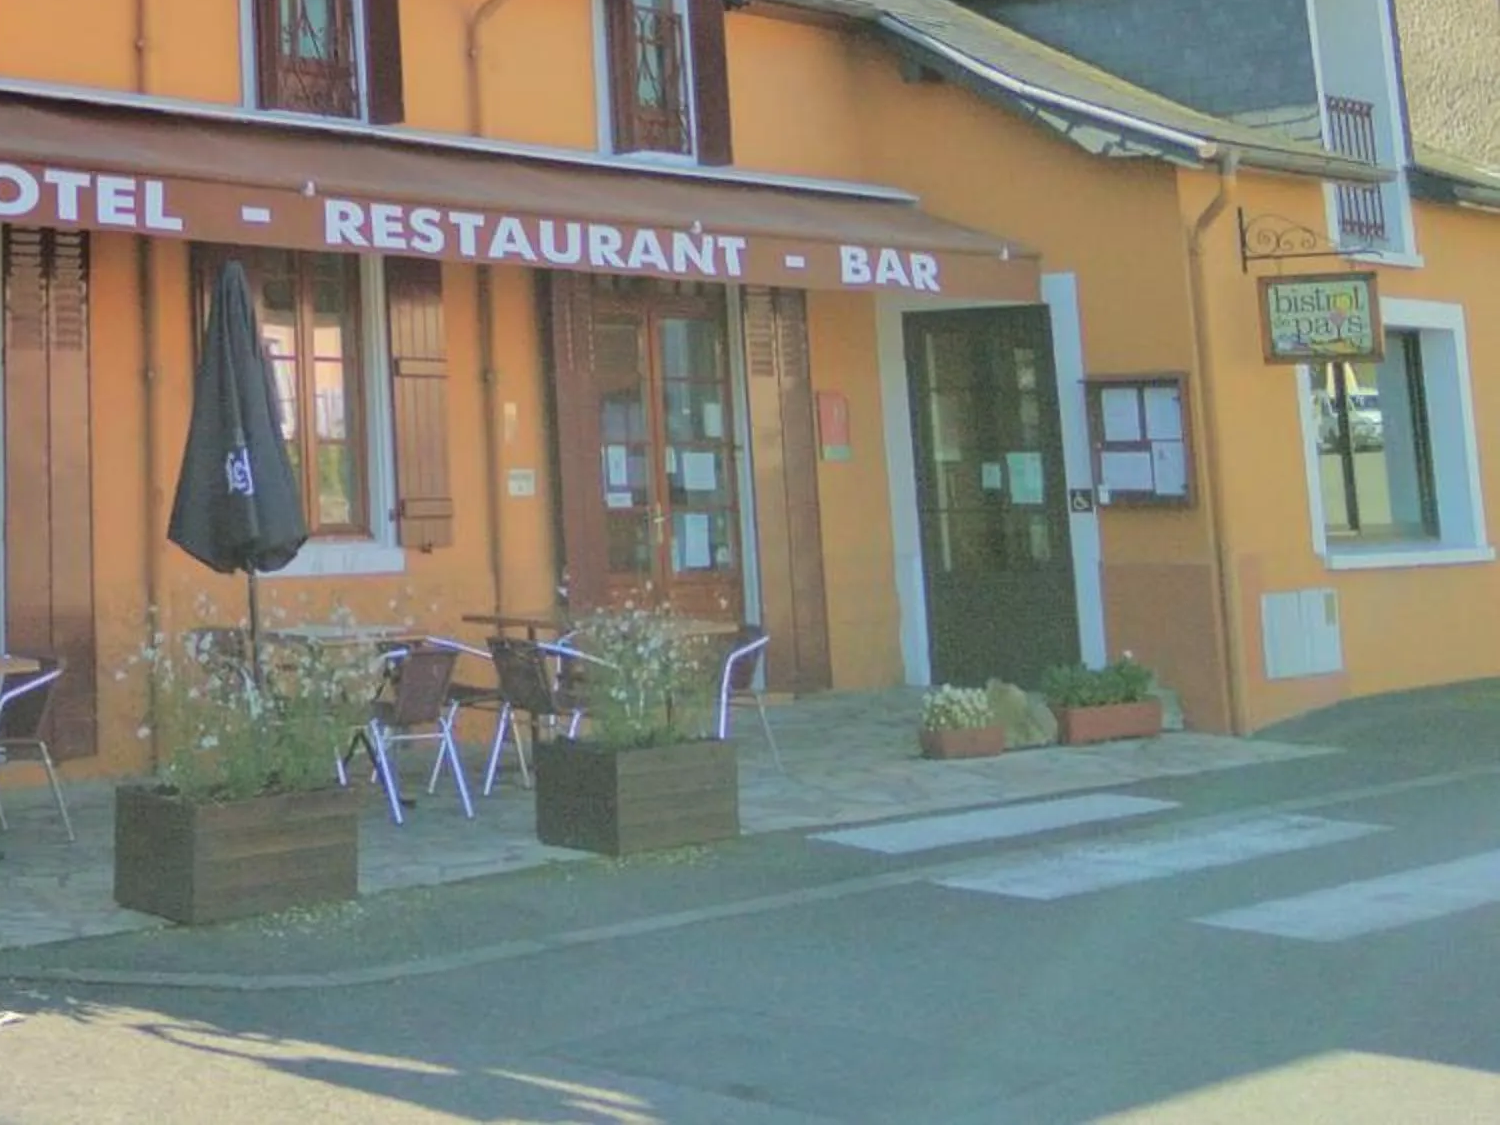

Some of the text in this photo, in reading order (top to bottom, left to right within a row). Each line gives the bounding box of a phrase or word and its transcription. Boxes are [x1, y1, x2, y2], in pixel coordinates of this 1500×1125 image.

[241, 206, 270, 222] -
[324, 199, 746, 277] RESTAURANT
[785, 256, 805, 269] -
[840, 245, 941, 292] BAR
